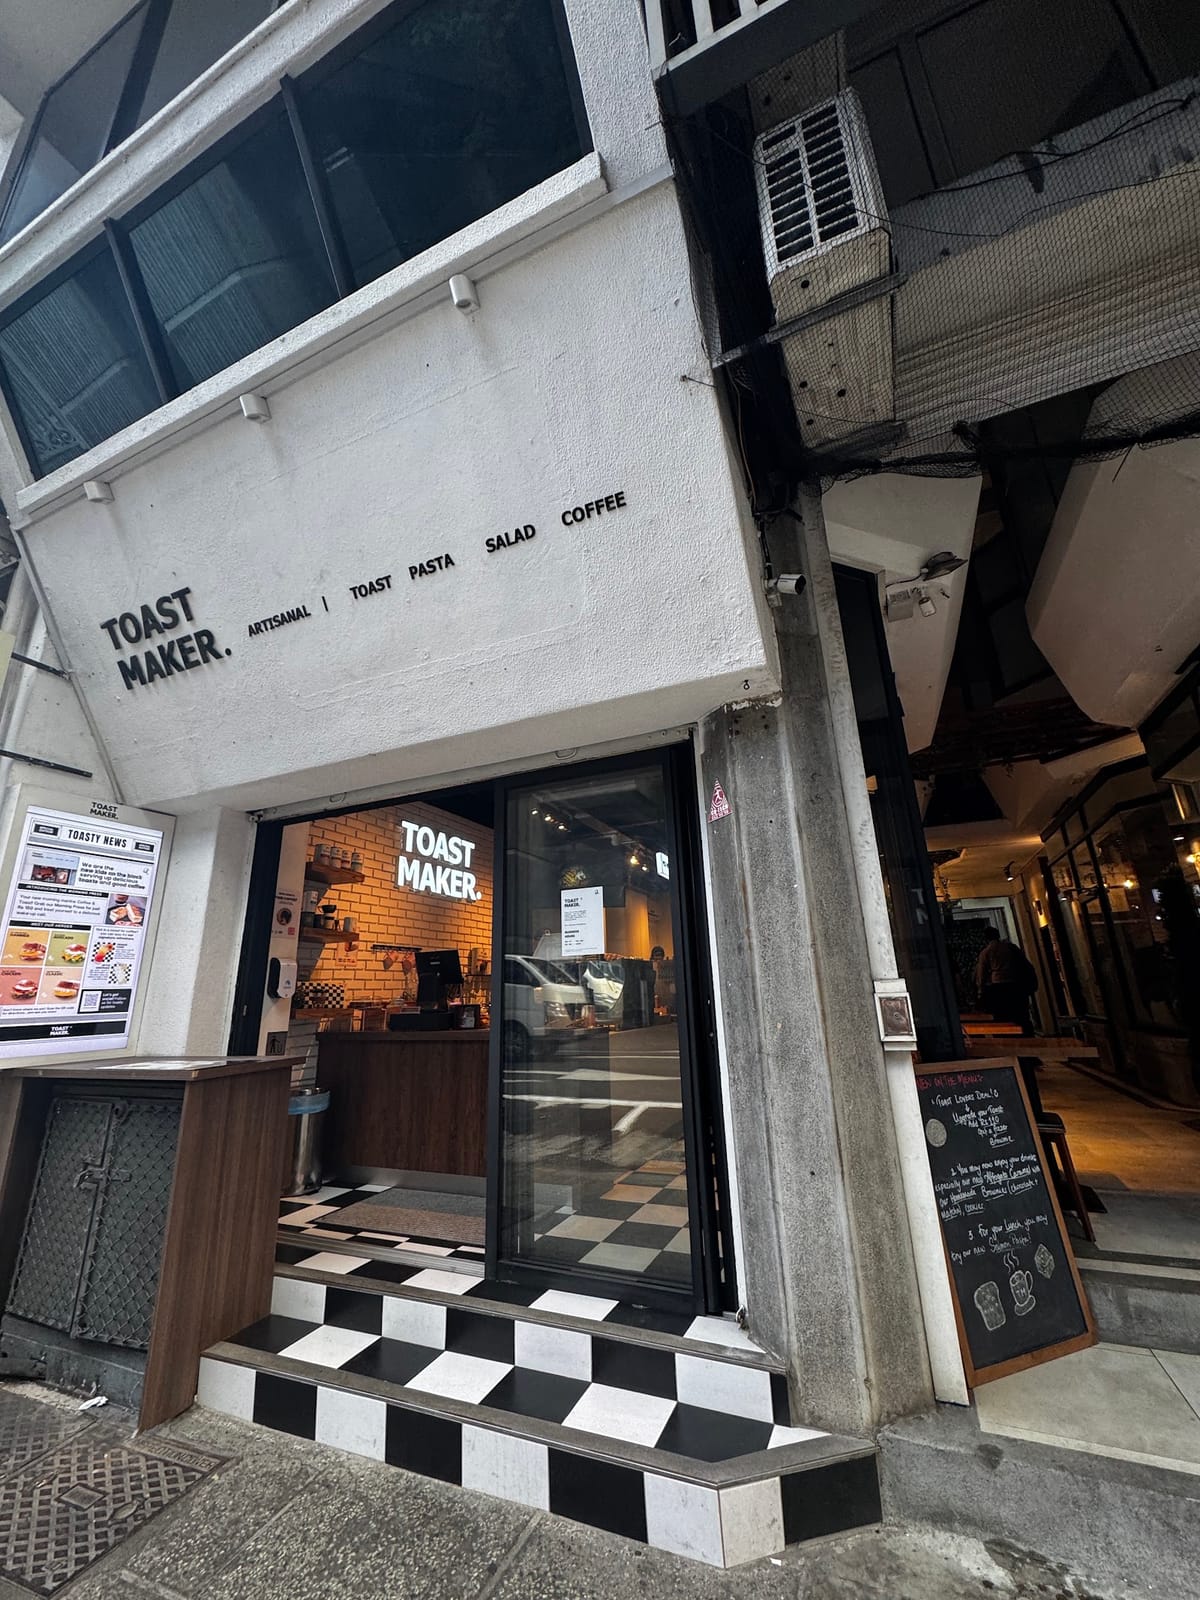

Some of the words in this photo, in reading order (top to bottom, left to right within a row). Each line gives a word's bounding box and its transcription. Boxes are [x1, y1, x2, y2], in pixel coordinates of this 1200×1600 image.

[248, 605, 312, 637] ARTISANAL
[350, 575, 392, 600] TOAST
[408, 554, 455, 580] PASTA
[485, 524, 536, 553] SALAD
[561, 491, 627, 526] COFFEE
[100, 586, 194, 650] TOAST
[117, 629, 232, 690] MAKER.
[90, 809, 119, 819] MAKER.
[91, 802, 118, 812] TOAST
[68, 829, 100, 844] TOASTY
[103, 836, 127, 848] NEWS
[402, 820, 476, 868] TOAST
[398, 856, 482, 900] MAKER.
[969, 1166, 981, 1176] may
[992, 1225, 1002, 1240] your
[1024, 1218, 1035, 1231] you
[1035, 1215, 1048, 1226] may
[951, 1251, 963, 1264] try
